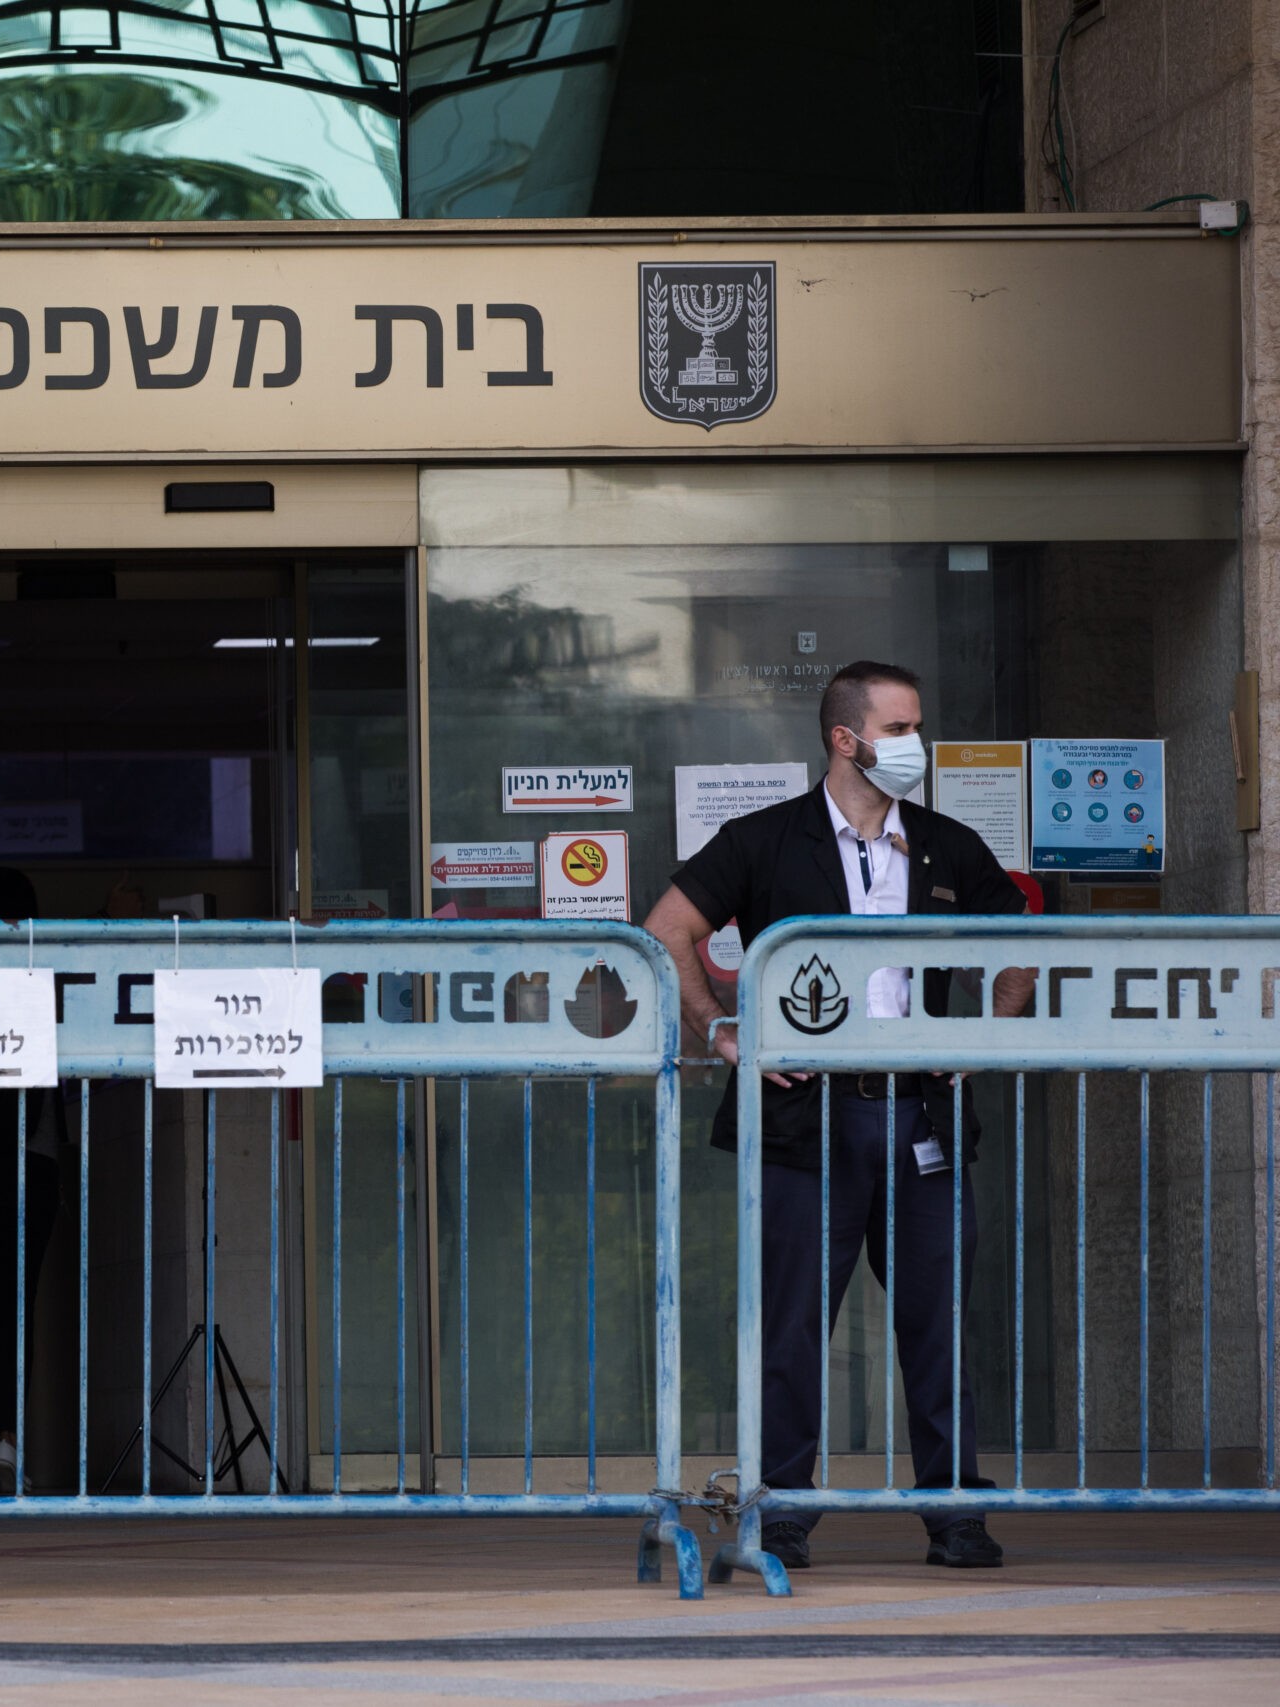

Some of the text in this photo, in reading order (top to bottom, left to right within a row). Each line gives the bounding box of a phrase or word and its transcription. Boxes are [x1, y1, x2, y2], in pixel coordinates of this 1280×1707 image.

[355, 303, 553, 388] בית
[672, 386, 746, 412] ישראל
[721, 664, 749, 680] לציון
[755, 664, 788, 679] ראשון
[794, 663, 830, 676] השלום
[507, 770, 628, 795] למעלית חניון
[433, 863, 533, 874] זהירות דלת אוטומטית!
[558, 897, 578, 905] בבנין
[600, 895, 625, 904] העישון
[214, 994, 263, 1016] תור
[174, 1028, 304, 1058] למזכירות
